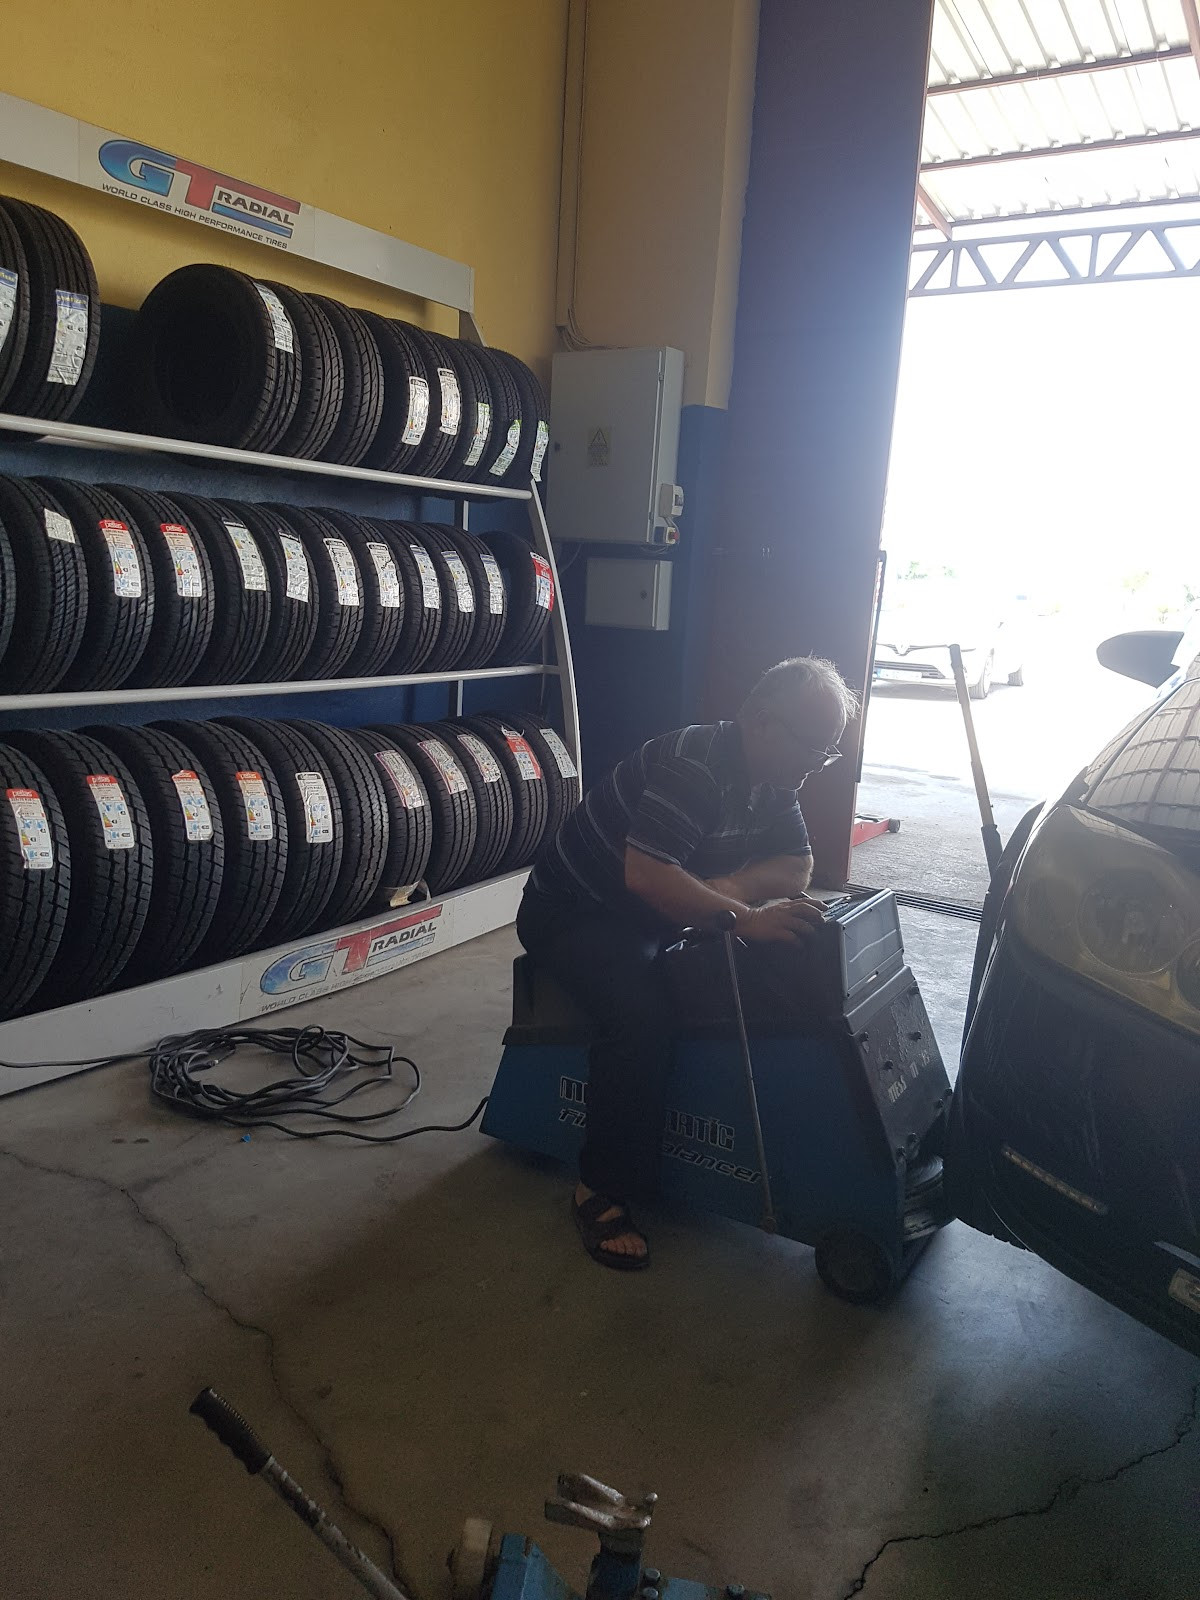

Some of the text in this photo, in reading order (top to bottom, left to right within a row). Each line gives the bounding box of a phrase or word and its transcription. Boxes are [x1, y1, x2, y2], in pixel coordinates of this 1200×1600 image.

[98, 139, 301, 226] GT RADIAL
[102, 183, 288, 250] WORLD CLASS HIGH PERFORMANCE TIRES
[259, 904, 444, 996] GT
[372, 922, 437, 953] RADIAL
